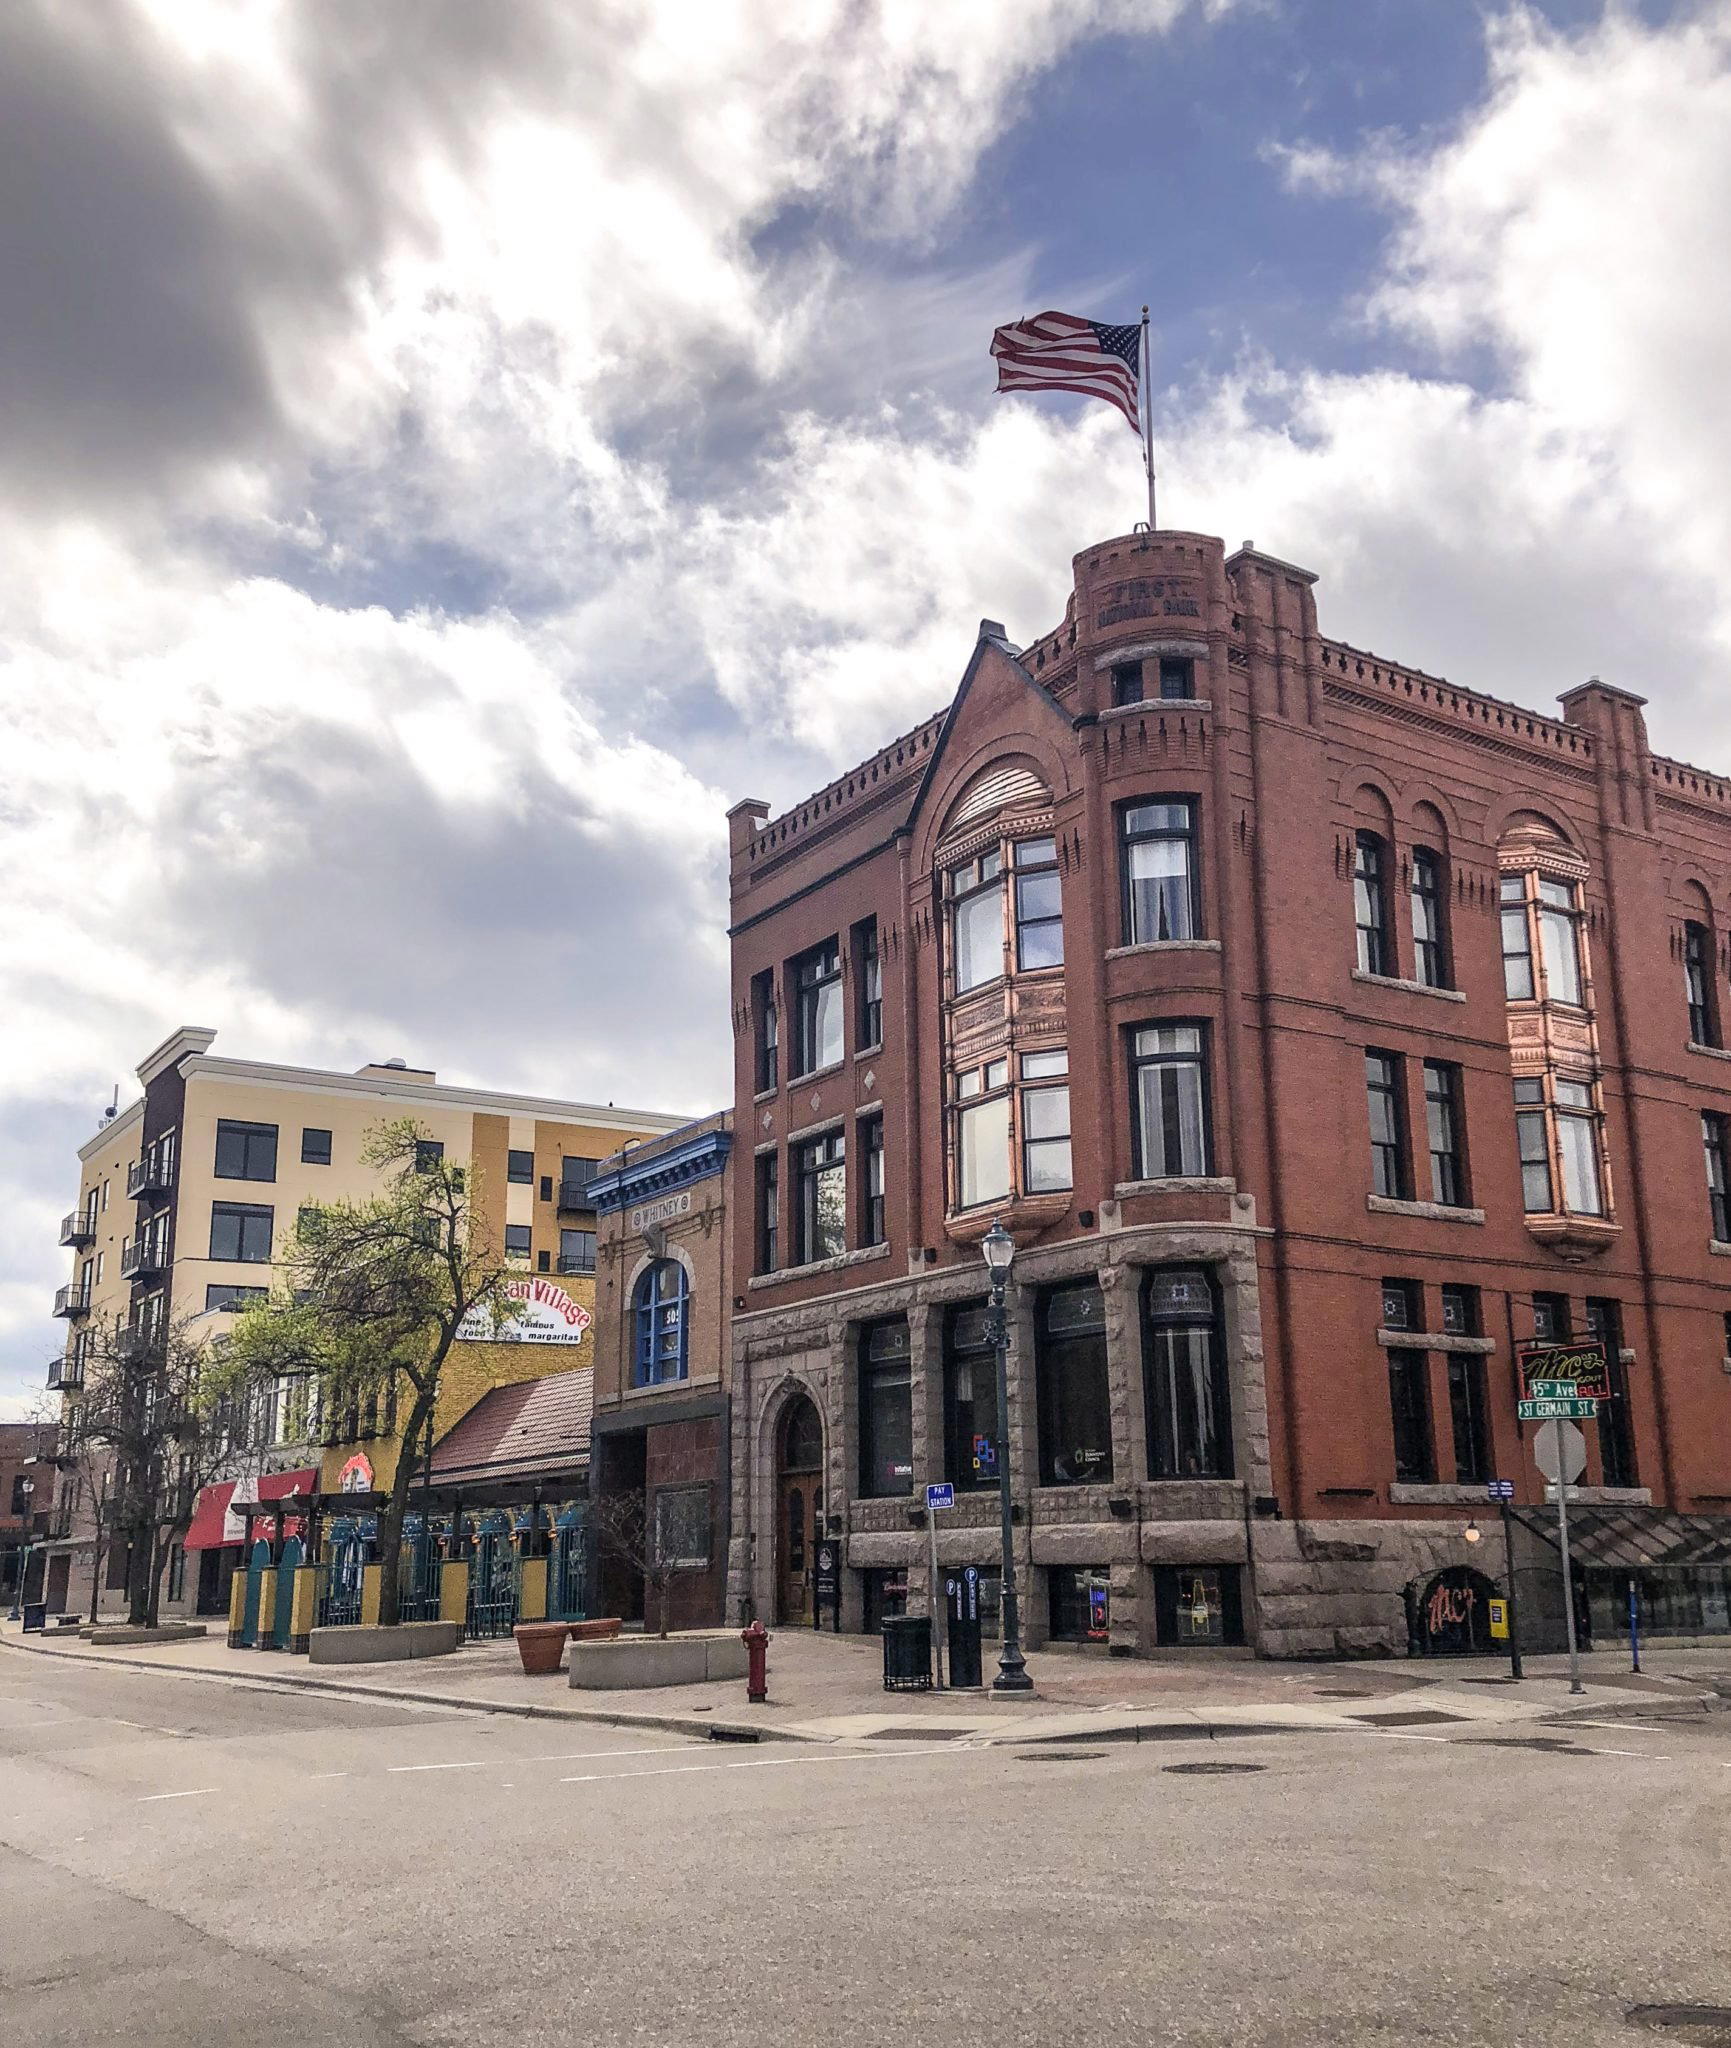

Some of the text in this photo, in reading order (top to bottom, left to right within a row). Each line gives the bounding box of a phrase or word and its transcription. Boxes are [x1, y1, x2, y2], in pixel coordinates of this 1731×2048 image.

[642, 1198, 679, 1223] WHITNEY
[533, 1279, 590, 1327] Village
[520, 1320, 555, 1329] famous
[528, 1332, 579, 1341] margaritas
[1536, 1382, 1550, 1397] 5th
[1555, 1382, 1575, 1397] Ave
[1524, 1401, 1588, 1416] ST GERMAIN ST
[934, 1486, 945, 1495] PAY
[930, 1497, 951, 1506] STATION
